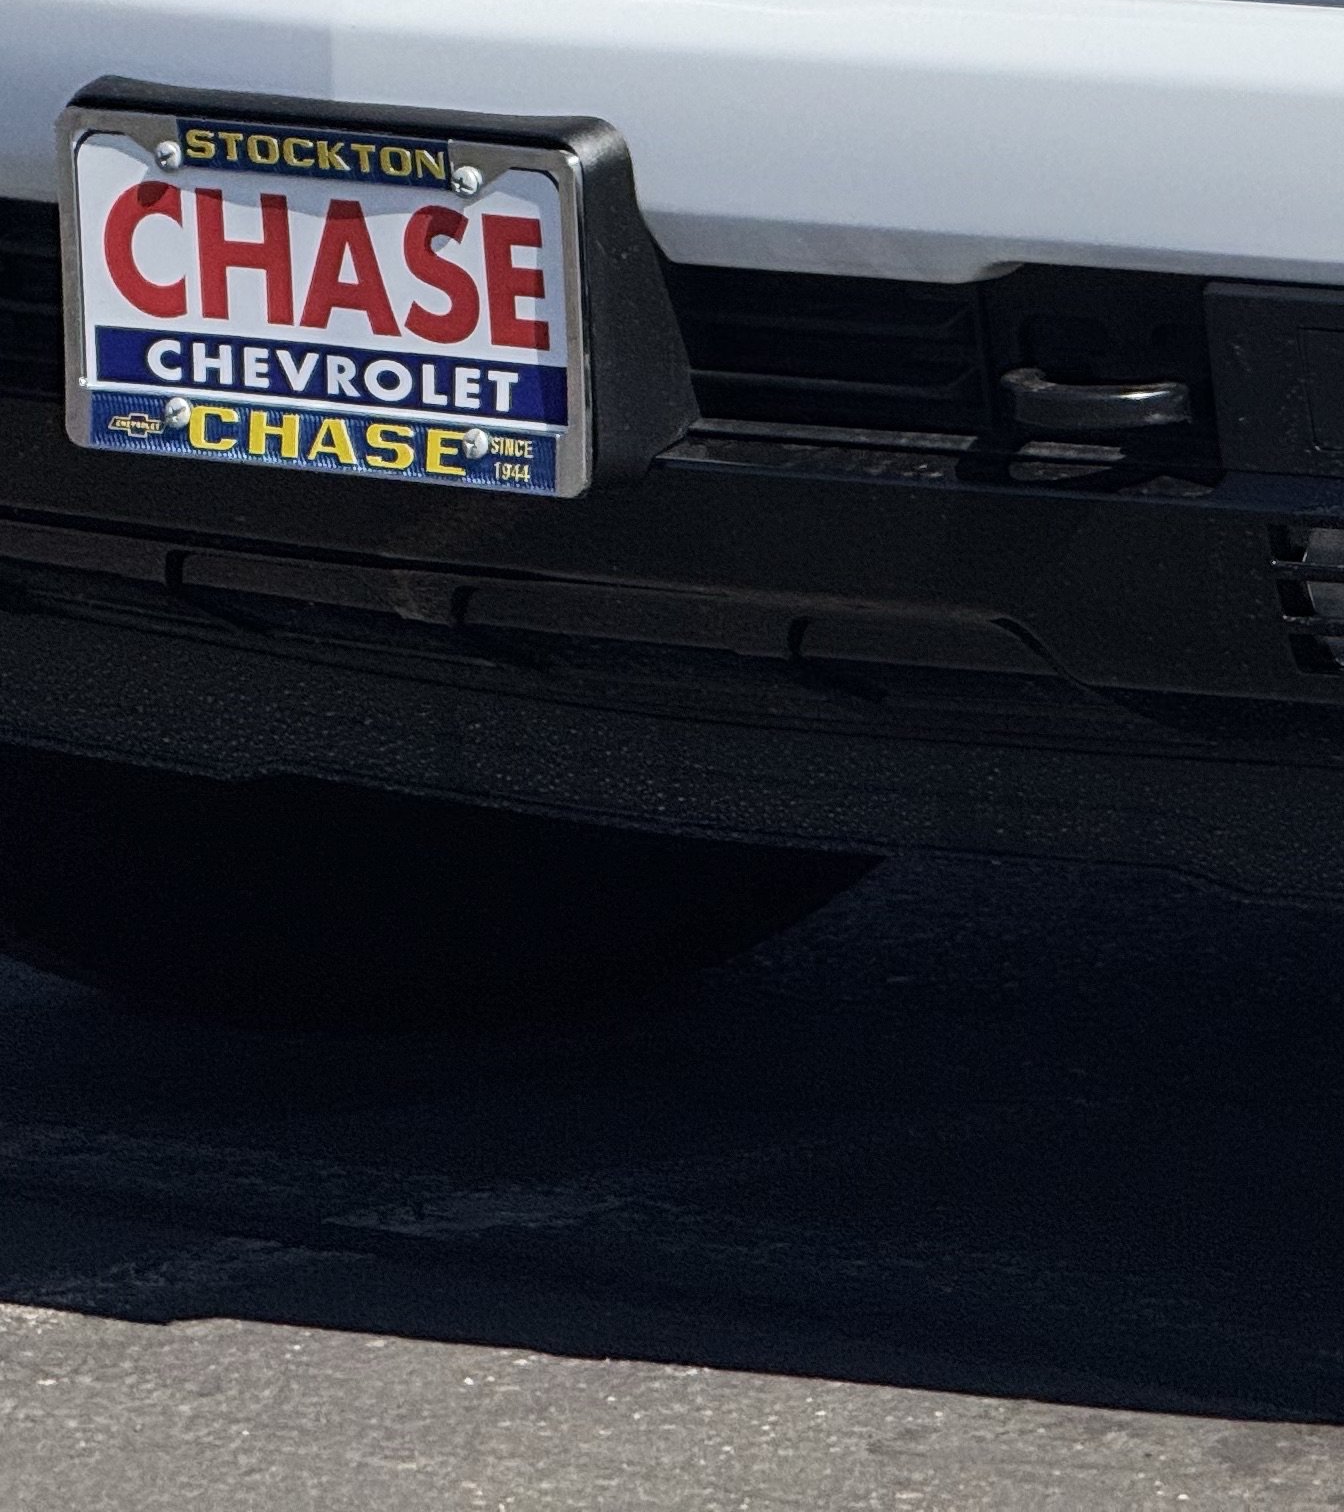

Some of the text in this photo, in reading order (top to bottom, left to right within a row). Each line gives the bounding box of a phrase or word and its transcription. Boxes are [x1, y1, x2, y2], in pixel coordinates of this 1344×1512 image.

[185, 128, 447, 181] STOCKTON
[103, 179, 551, 352] CHASE
[146, 338, 520, 414] CHEVROLET
[187, 404, 469, 478] CHASE
[490, 436, 534, 459] SINCE
[493, 461, 531, 483] 1944
